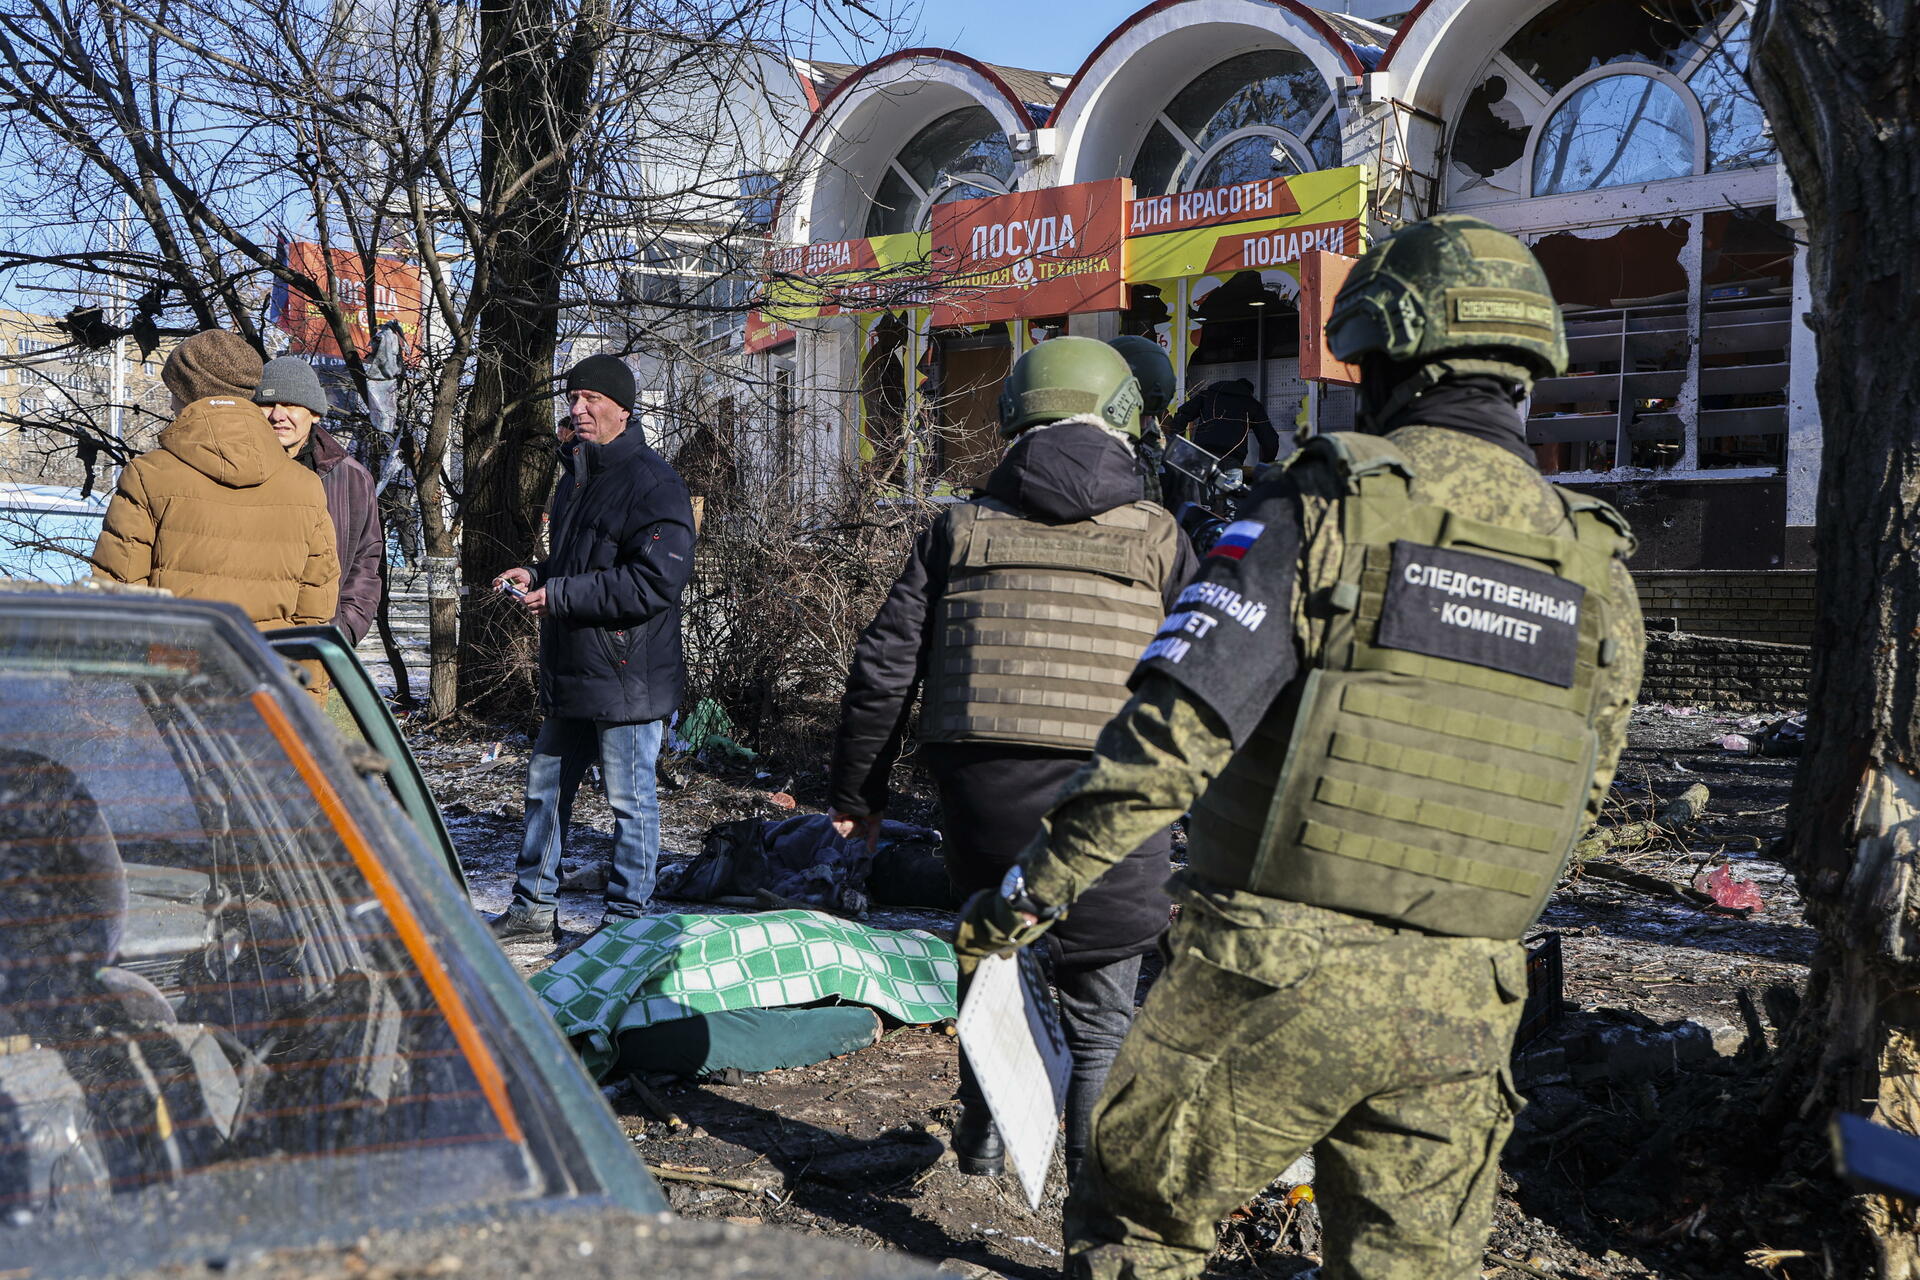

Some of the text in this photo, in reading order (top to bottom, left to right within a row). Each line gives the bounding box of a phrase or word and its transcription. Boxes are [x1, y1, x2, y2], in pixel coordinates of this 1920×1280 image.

[1131, 180, 1273, 233] ДЛЯ КРАСОТЫ
[806, 242, 851, 274] ДОМА
[972, 214, 1076, 261] ПОСУДА
[1243, 226, 1344, 267] ПОДАРКИ
[1039, 257, 1110, 279] ТЕХНИКА
[1404, 563, 1577, 626] СЛЕДСТВЕННЫЙ
[1441, 601, 1543, 645] КОМИТЕТ
